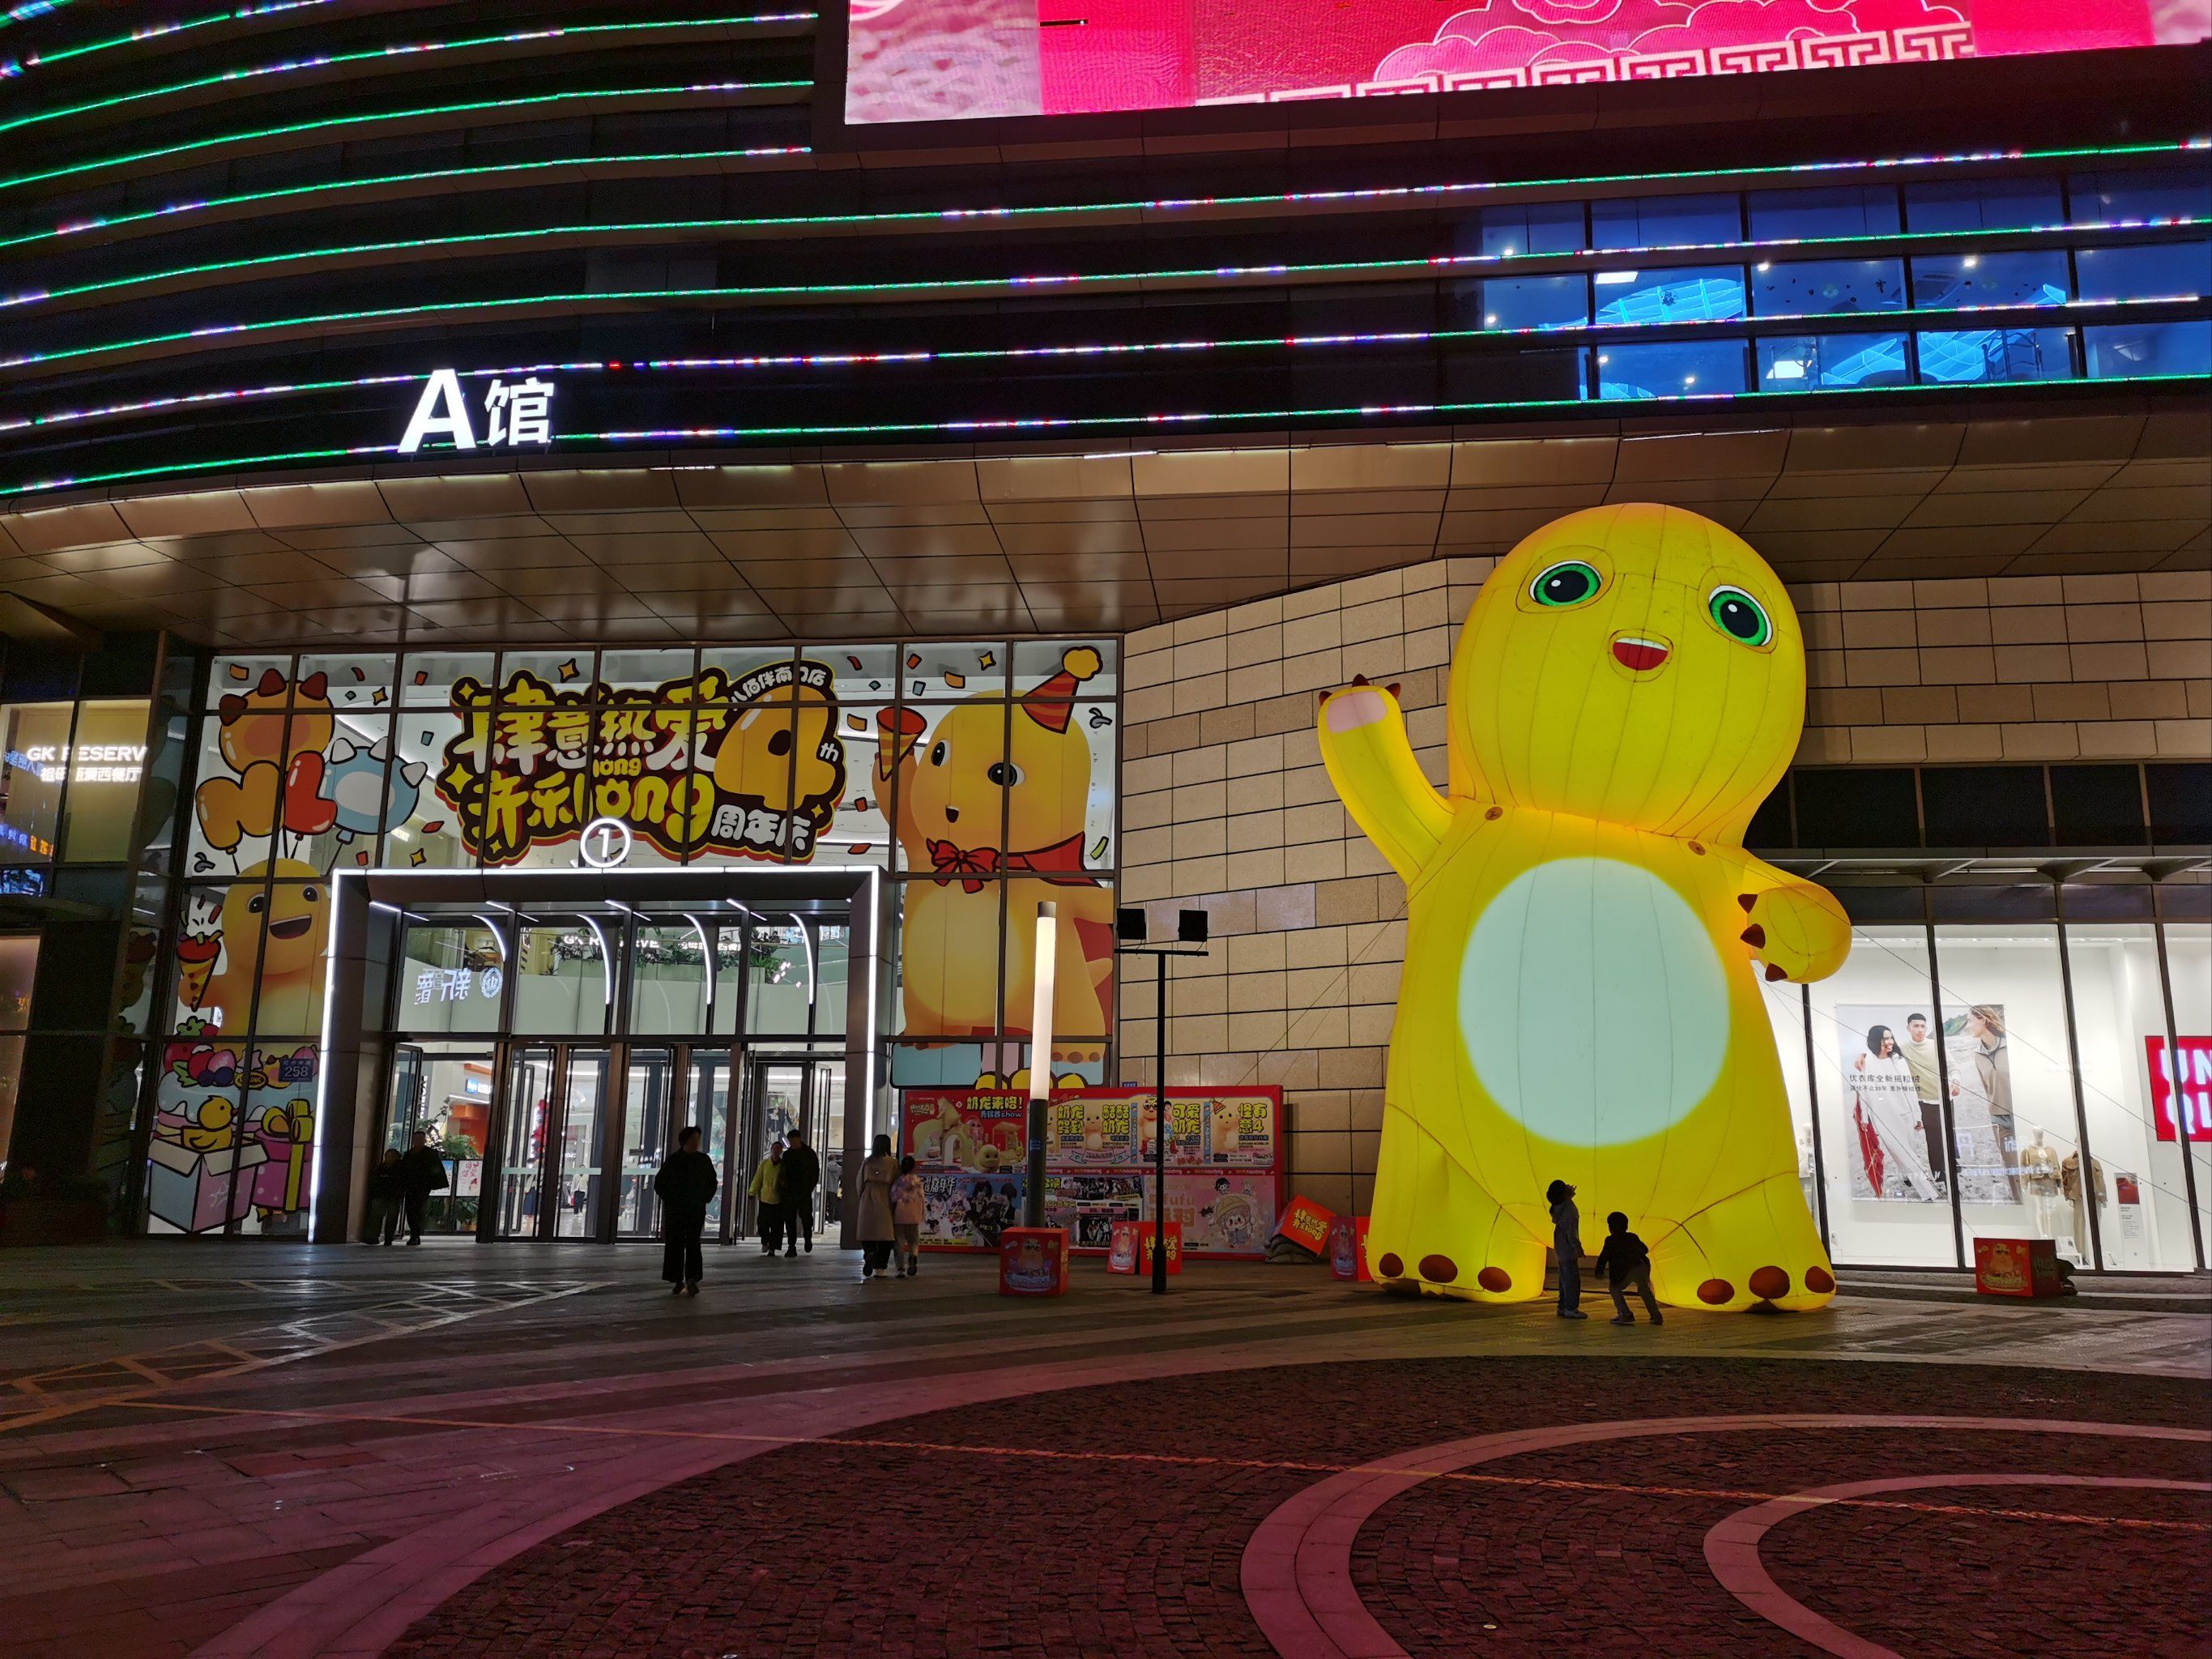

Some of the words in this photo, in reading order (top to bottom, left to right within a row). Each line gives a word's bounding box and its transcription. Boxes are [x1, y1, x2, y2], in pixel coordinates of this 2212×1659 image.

[453, 676, 729, 775] 肆意热爱
[27, 747, 55, 761] GK
[592, 758, 641, 778] long
[710, 804, 811, 851] 周年庆
[284, 1066, 309, 1077] 258
[1057, 1105, 1085, 1120] 奶龙
[1172, 1103, 1201, 1119] 可爱
[1102, 1120, 1130, 1134] 奶龙
[1172, 1119, 1201, 1134] 奶龙
